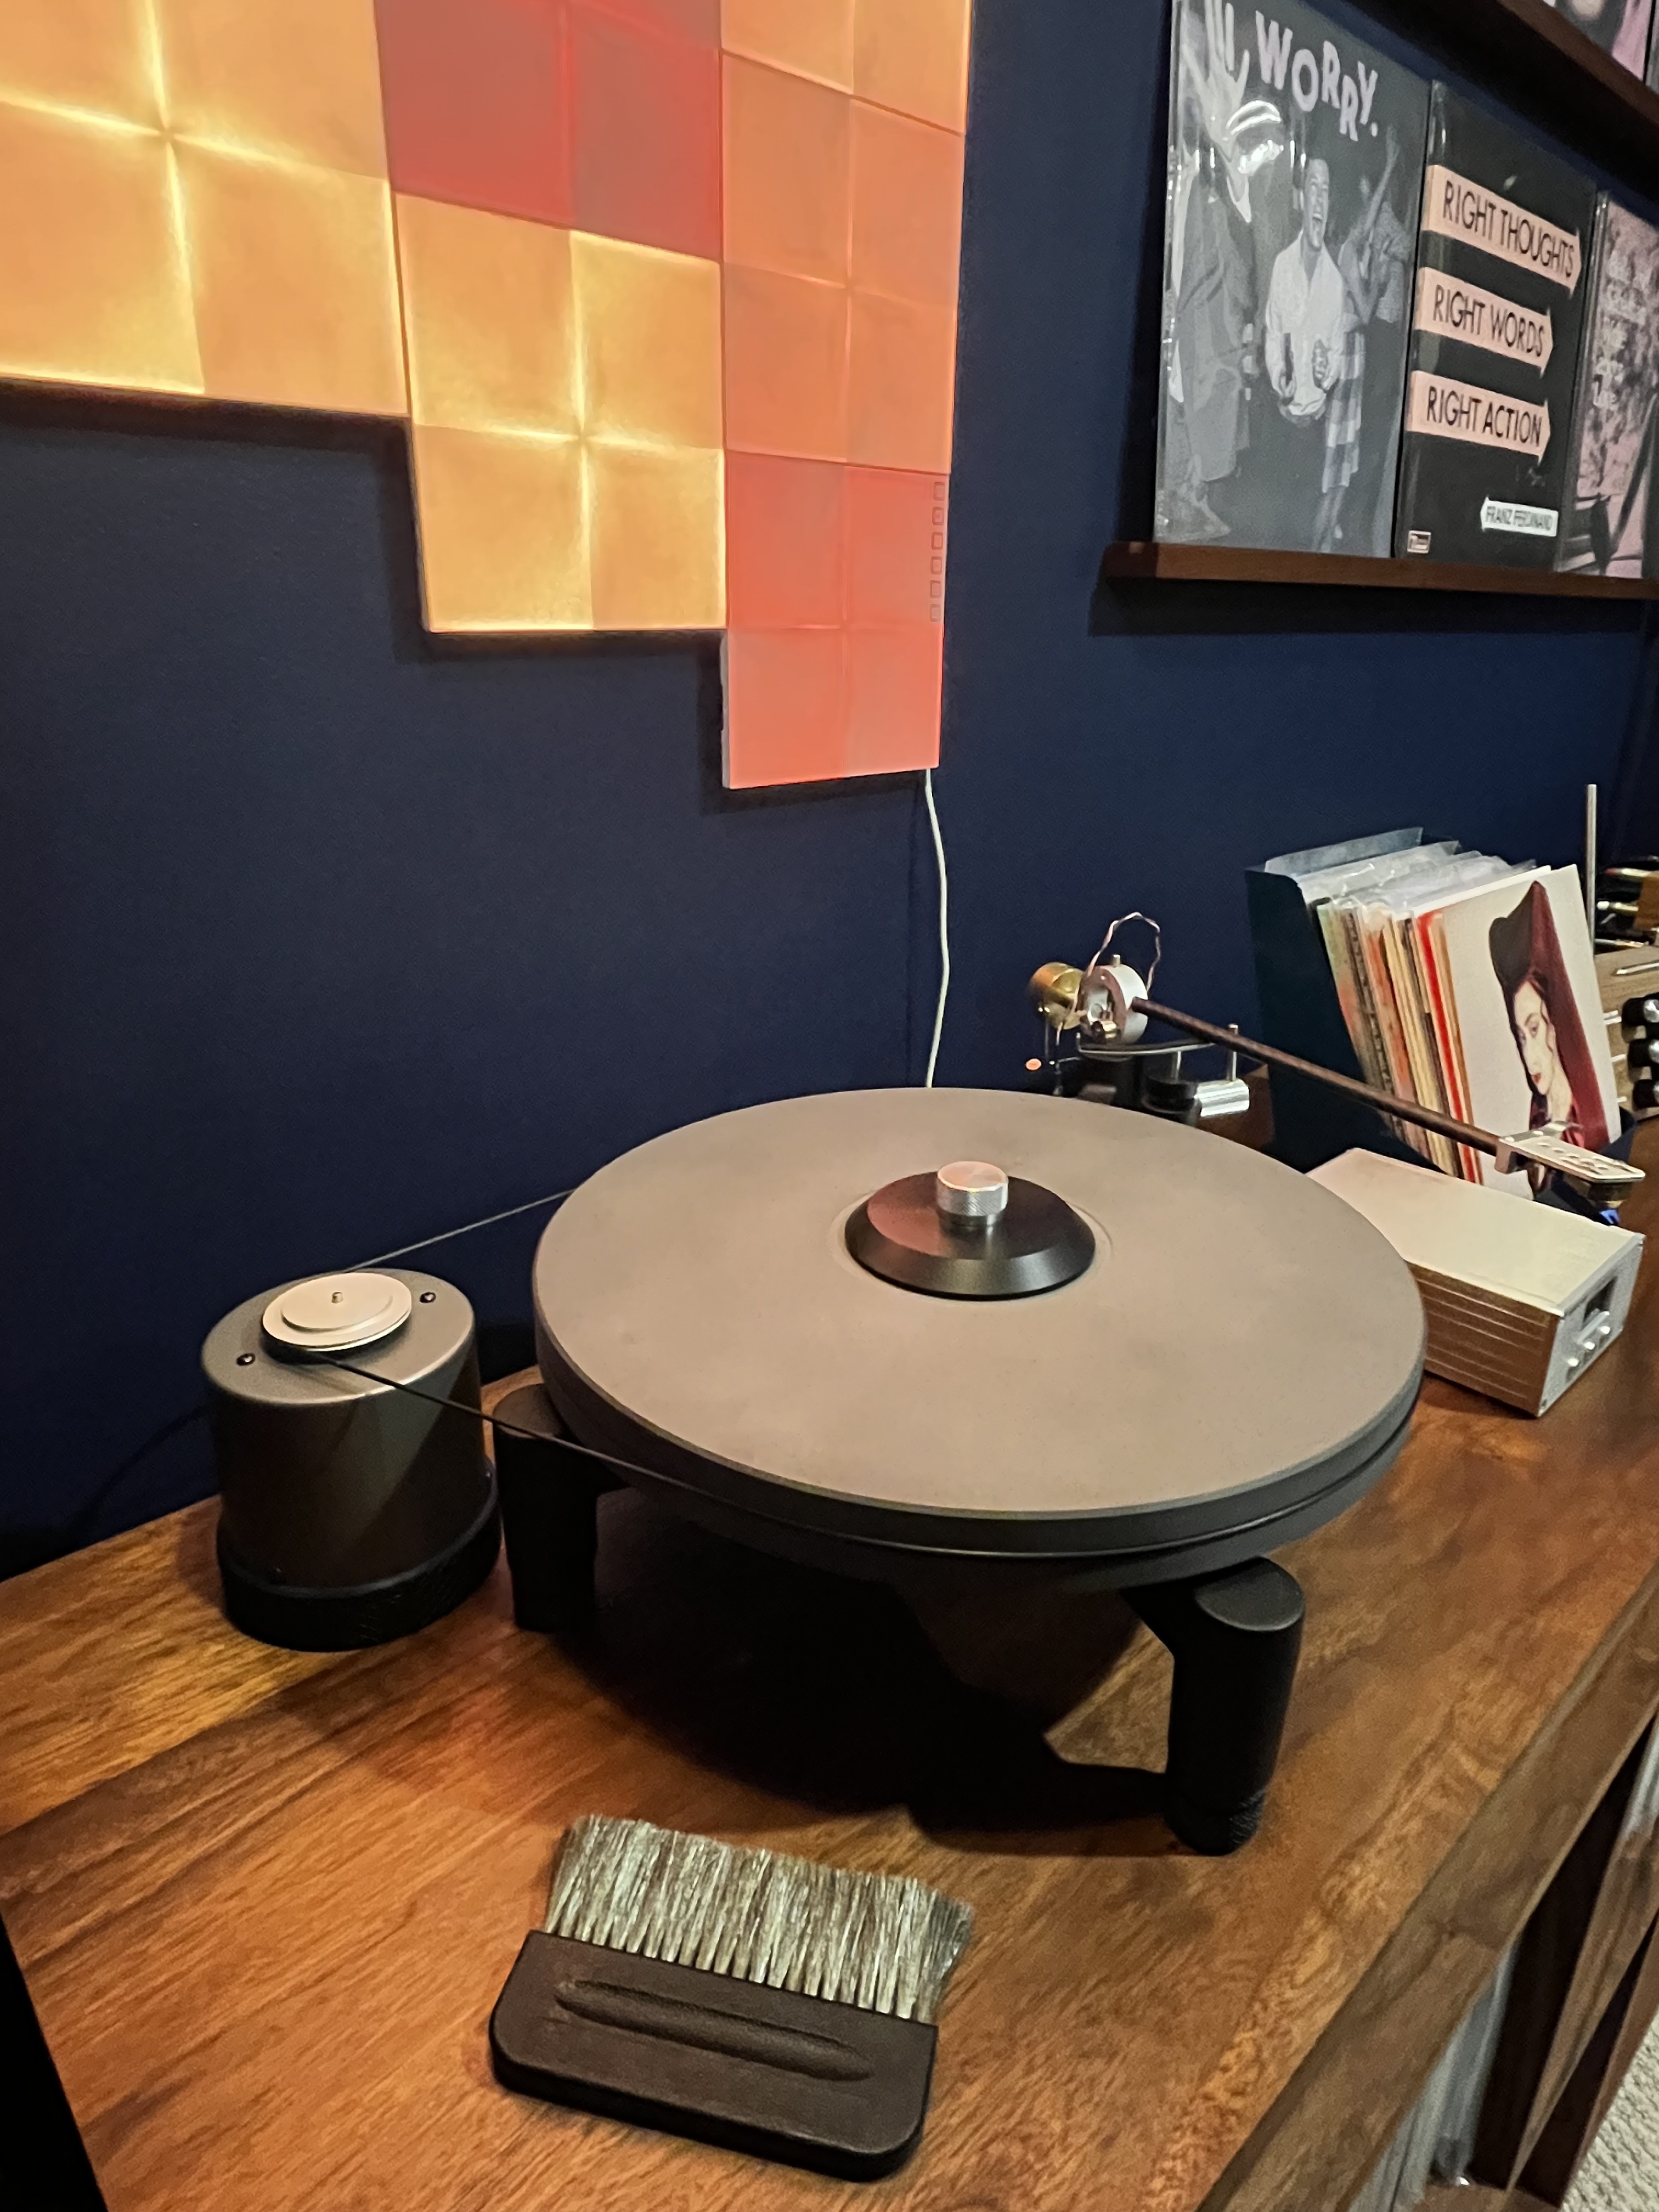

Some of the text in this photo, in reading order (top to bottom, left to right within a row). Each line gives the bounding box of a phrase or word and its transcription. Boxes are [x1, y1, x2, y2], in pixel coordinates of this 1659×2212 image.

[1255, 10, 1378, 142] WORRY.
[1443, 180, 1575, 278] RIGHT THOUGHTS
[1433, 284, 1545, 357] RIGHT WORDS
[1426, 385, 1543, 447] RIGHT ACTION
